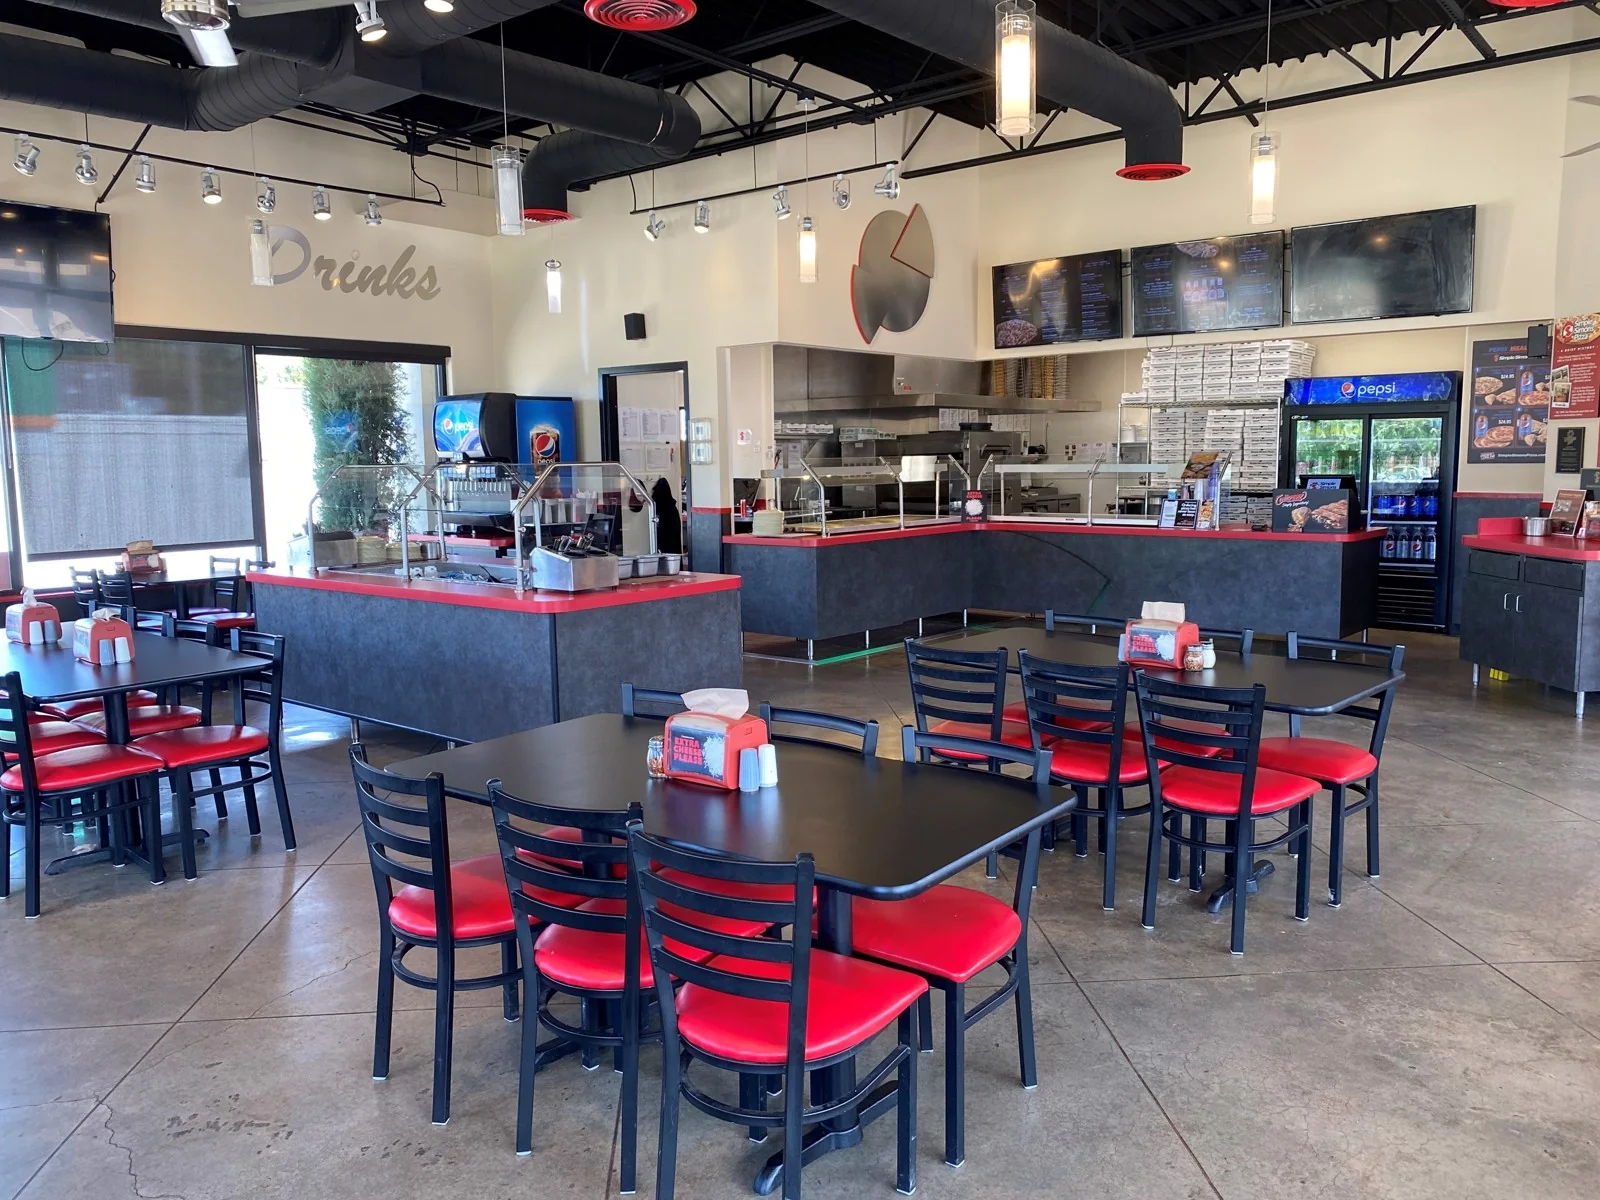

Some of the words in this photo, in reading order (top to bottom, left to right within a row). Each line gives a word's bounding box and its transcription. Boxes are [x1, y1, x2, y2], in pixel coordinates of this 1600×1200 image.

[266, 224, 441, 301] Drinks
[1357, 382, 1396, 397] pepsi
[454, 420, 474, 434] pepsi
[674, 737, 700, 749] EXTRA
[673, 745, 703, 758] CHEESE
[673, 753, 703, 765] PLEASE
